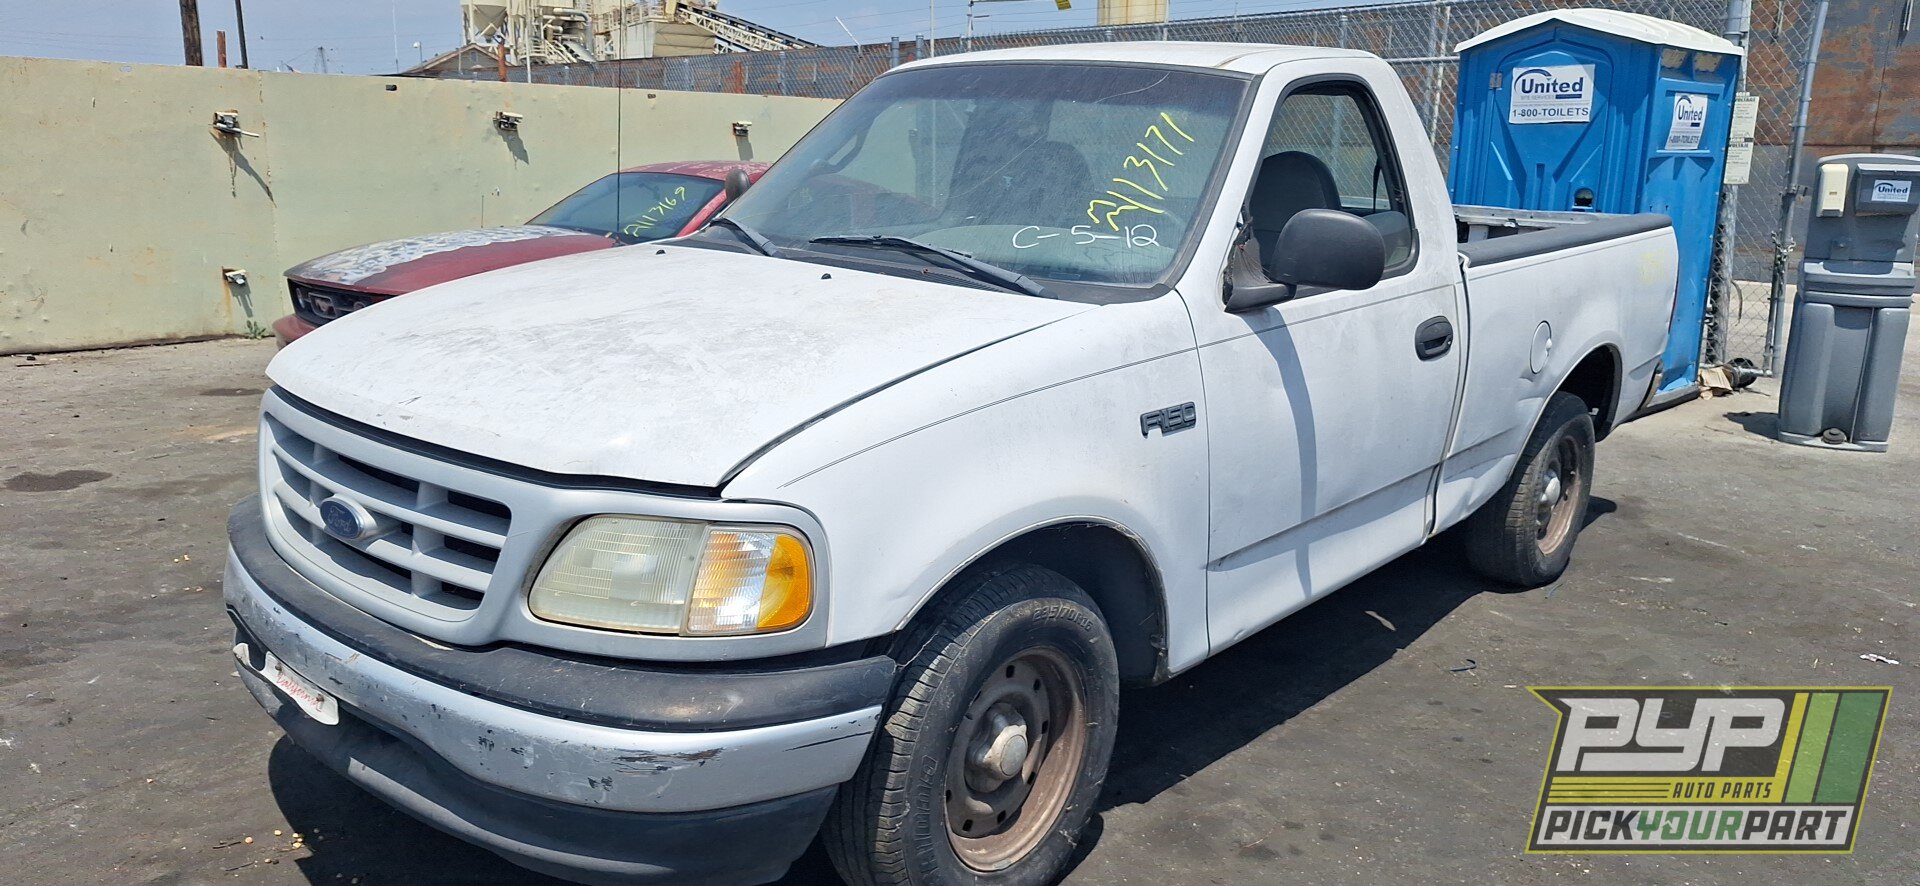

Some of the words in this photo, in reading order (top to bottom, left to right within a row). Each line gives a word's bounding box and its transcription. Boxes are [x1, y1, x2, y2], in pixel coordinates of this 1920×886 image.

[1521, 77, 1584, 94] United
[1512, 107, 1589, 117] 1-800-TOILETS
[1678, 105, 1703, 121] United
[327, 504, 352, 533] Ford
